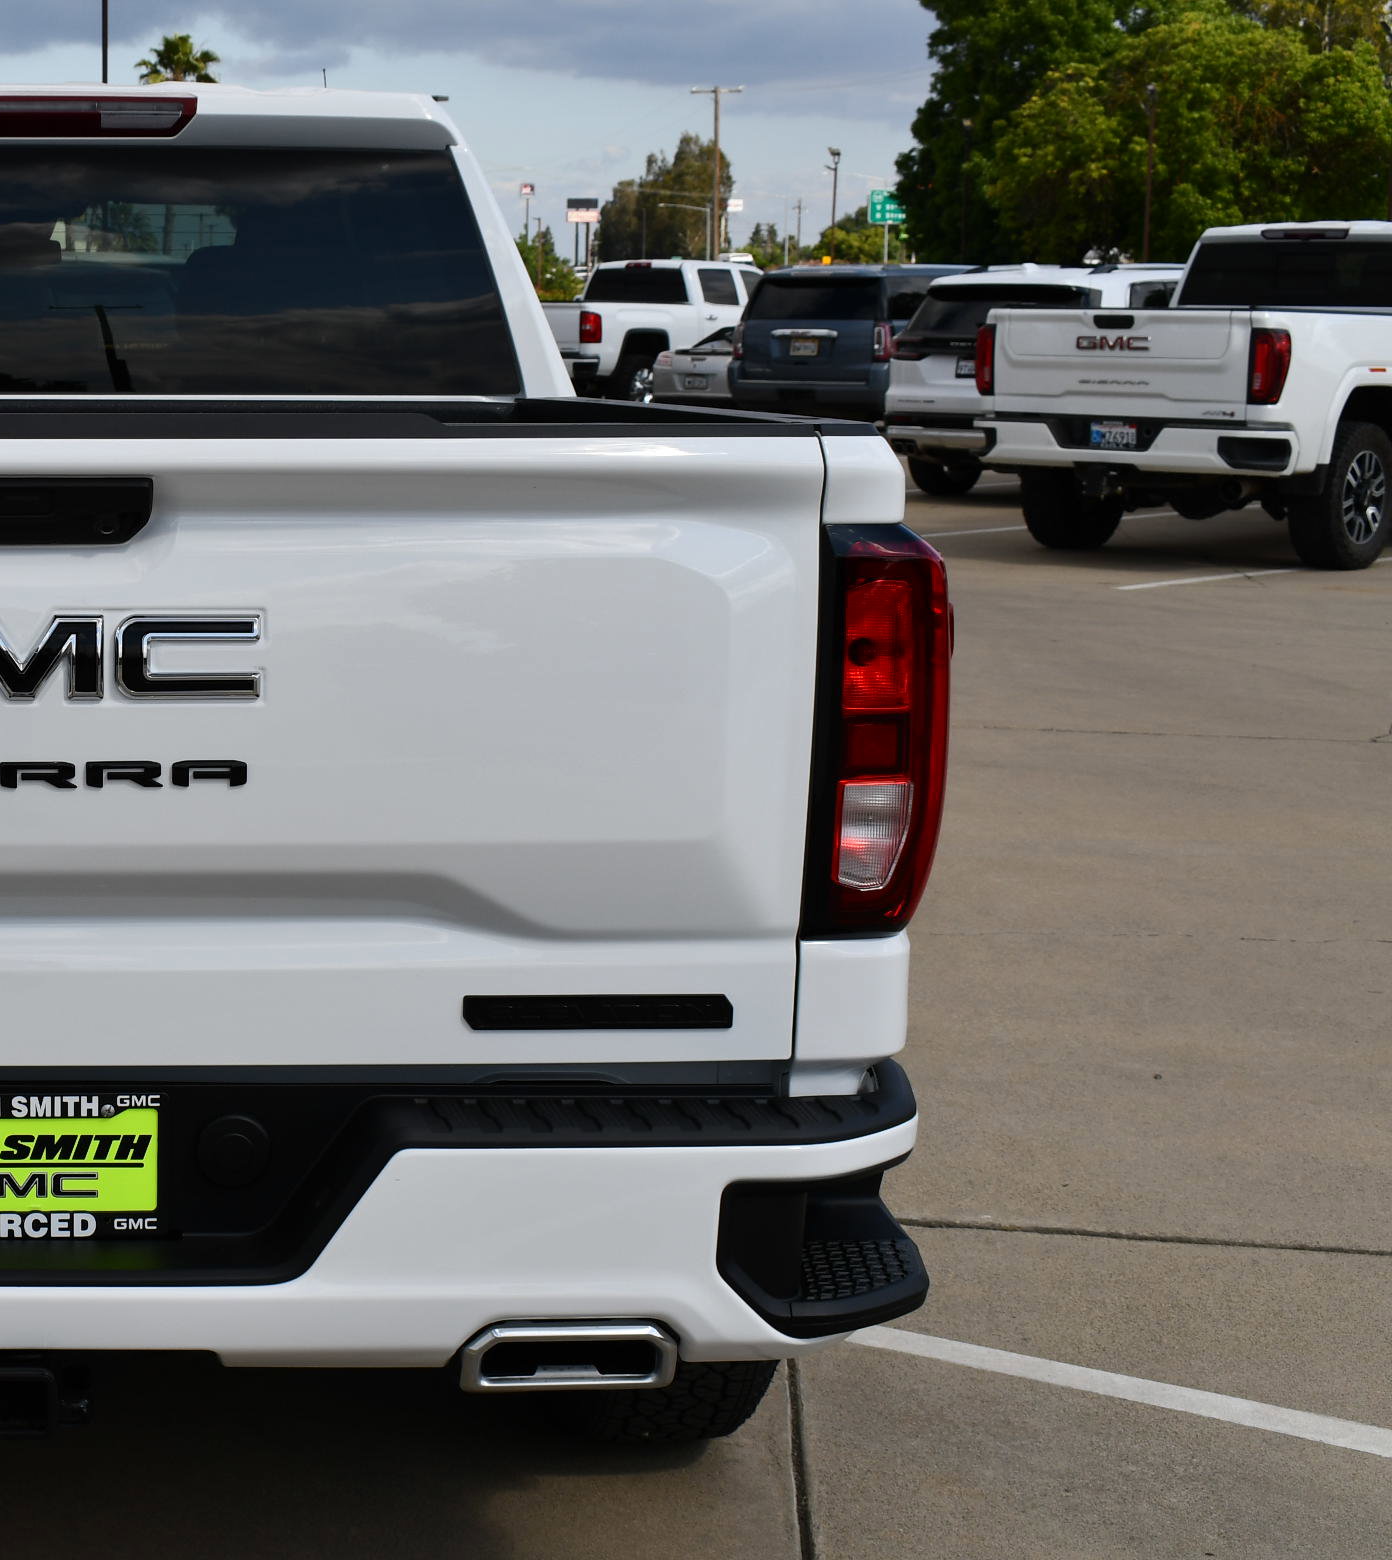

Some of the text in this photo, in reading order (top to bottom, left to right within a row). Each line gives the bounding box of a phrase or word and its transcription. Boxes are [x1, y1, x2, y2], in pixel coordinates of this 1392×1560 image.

[1076, 336, 1150, 351] GMC
[11, 1096, 99, 1118] SMITH
[117, 1094, 161, 1107] GMC
[0, 1134, 152, 1161] SMITH
[113, 1217, 158, 1230] GMC
